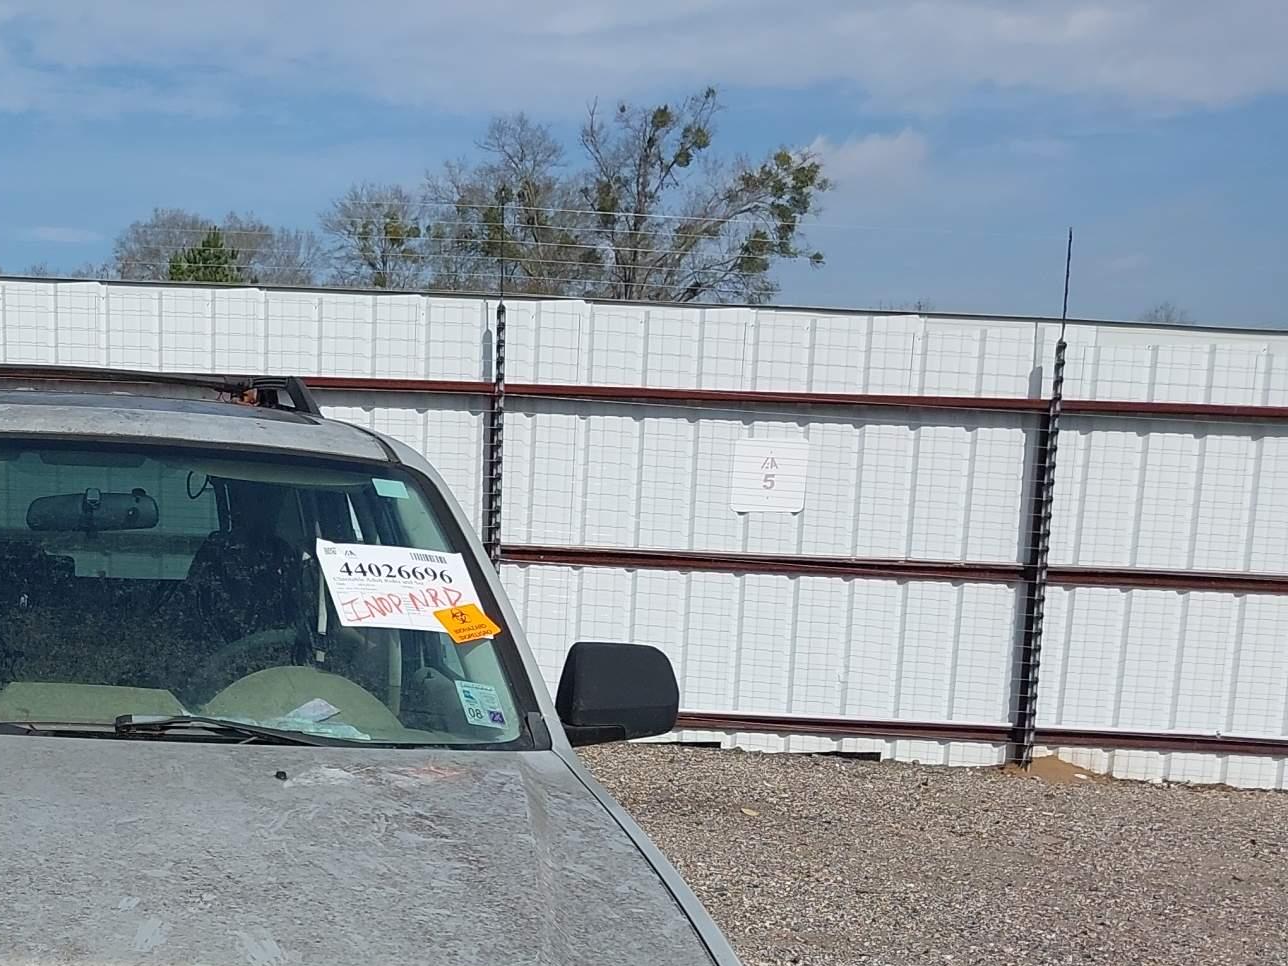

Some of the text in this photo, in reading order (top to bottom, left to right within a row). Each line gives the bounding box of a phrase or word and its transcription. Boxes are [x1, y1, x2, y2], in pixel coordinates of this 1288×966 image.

[762, 473, 776, 490] 5
[339, 561, 453, 584] 44026696
[341, 592, 403, 622] INOP
[408, 586, 462, 611] NRD
[467, 707, 483, 720] 08
